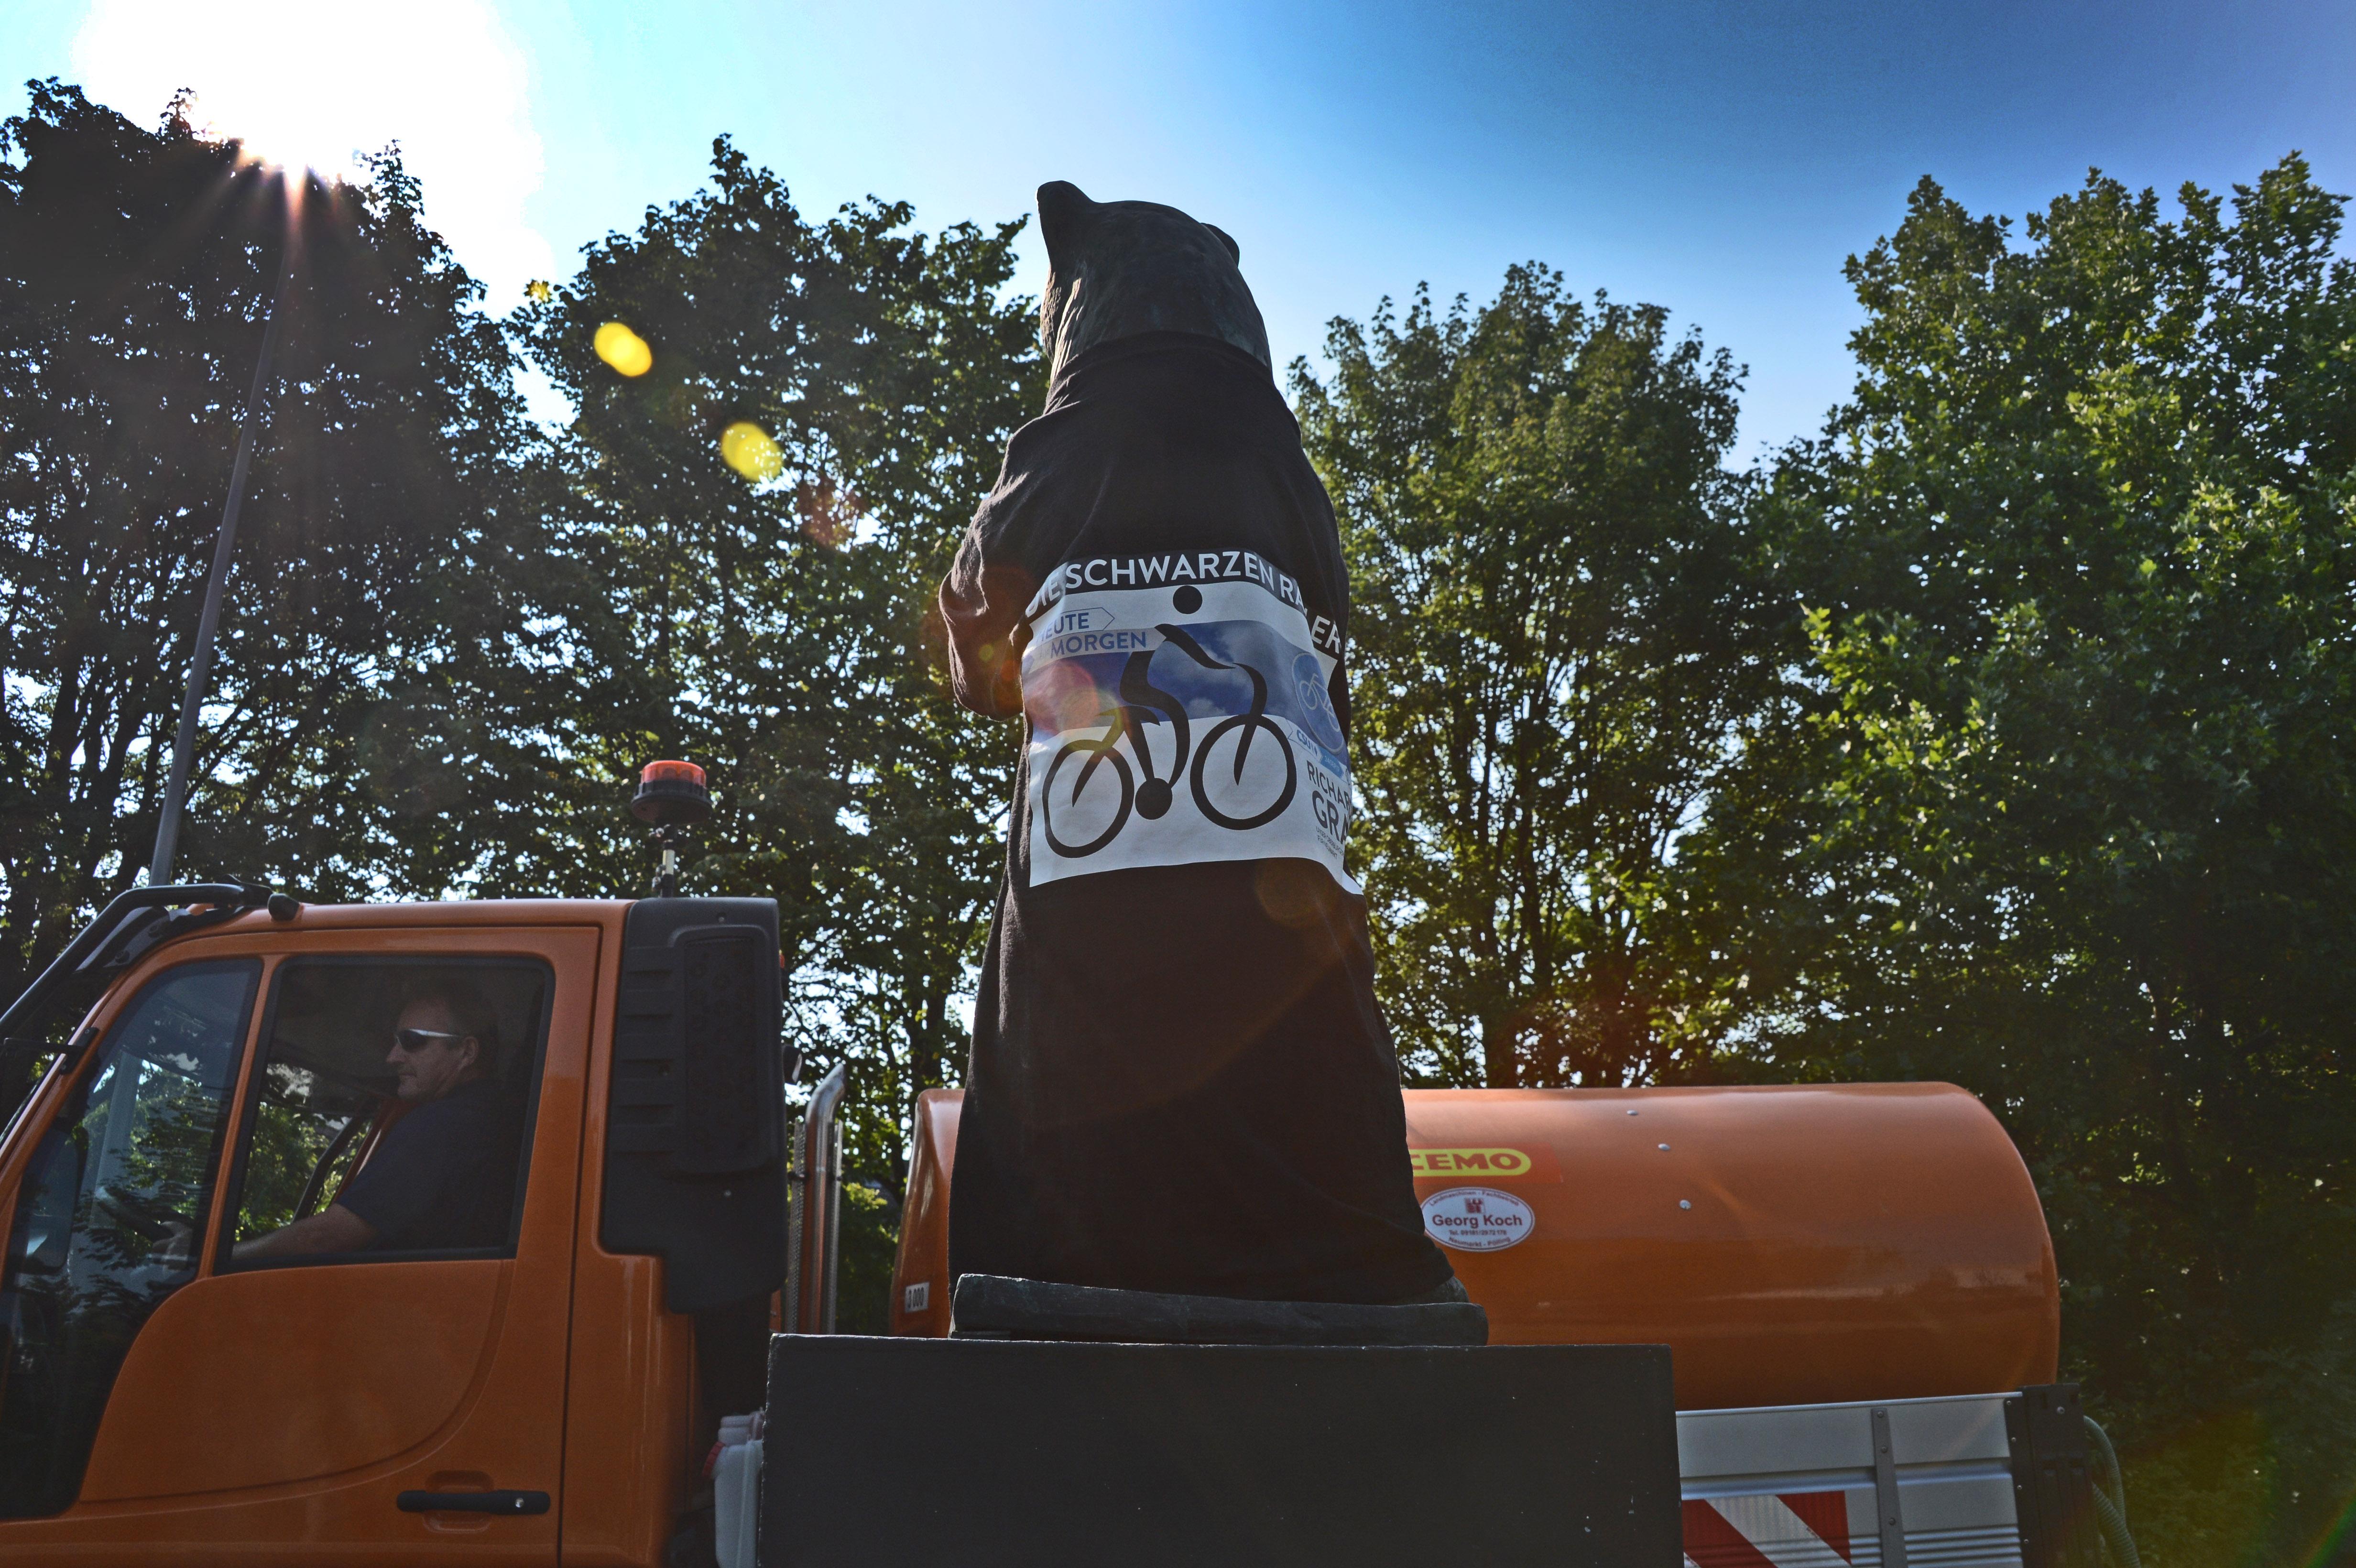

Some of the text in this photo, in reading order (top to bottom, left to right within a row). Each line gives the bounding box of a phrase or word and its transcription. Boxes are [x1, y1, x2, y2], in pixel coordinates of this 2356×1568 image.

[1066, 551, 1274, 591] SCHWARZEN
[1279, 574, 1342, 653] RAER
[1050, 631, 1146, 658] MORGEN
[1297, 730, 1311, 750] CSU
[1306, 760, 1351, 813] RICHAR
[1432, 1214, 1523, 1229] Georg Koch
